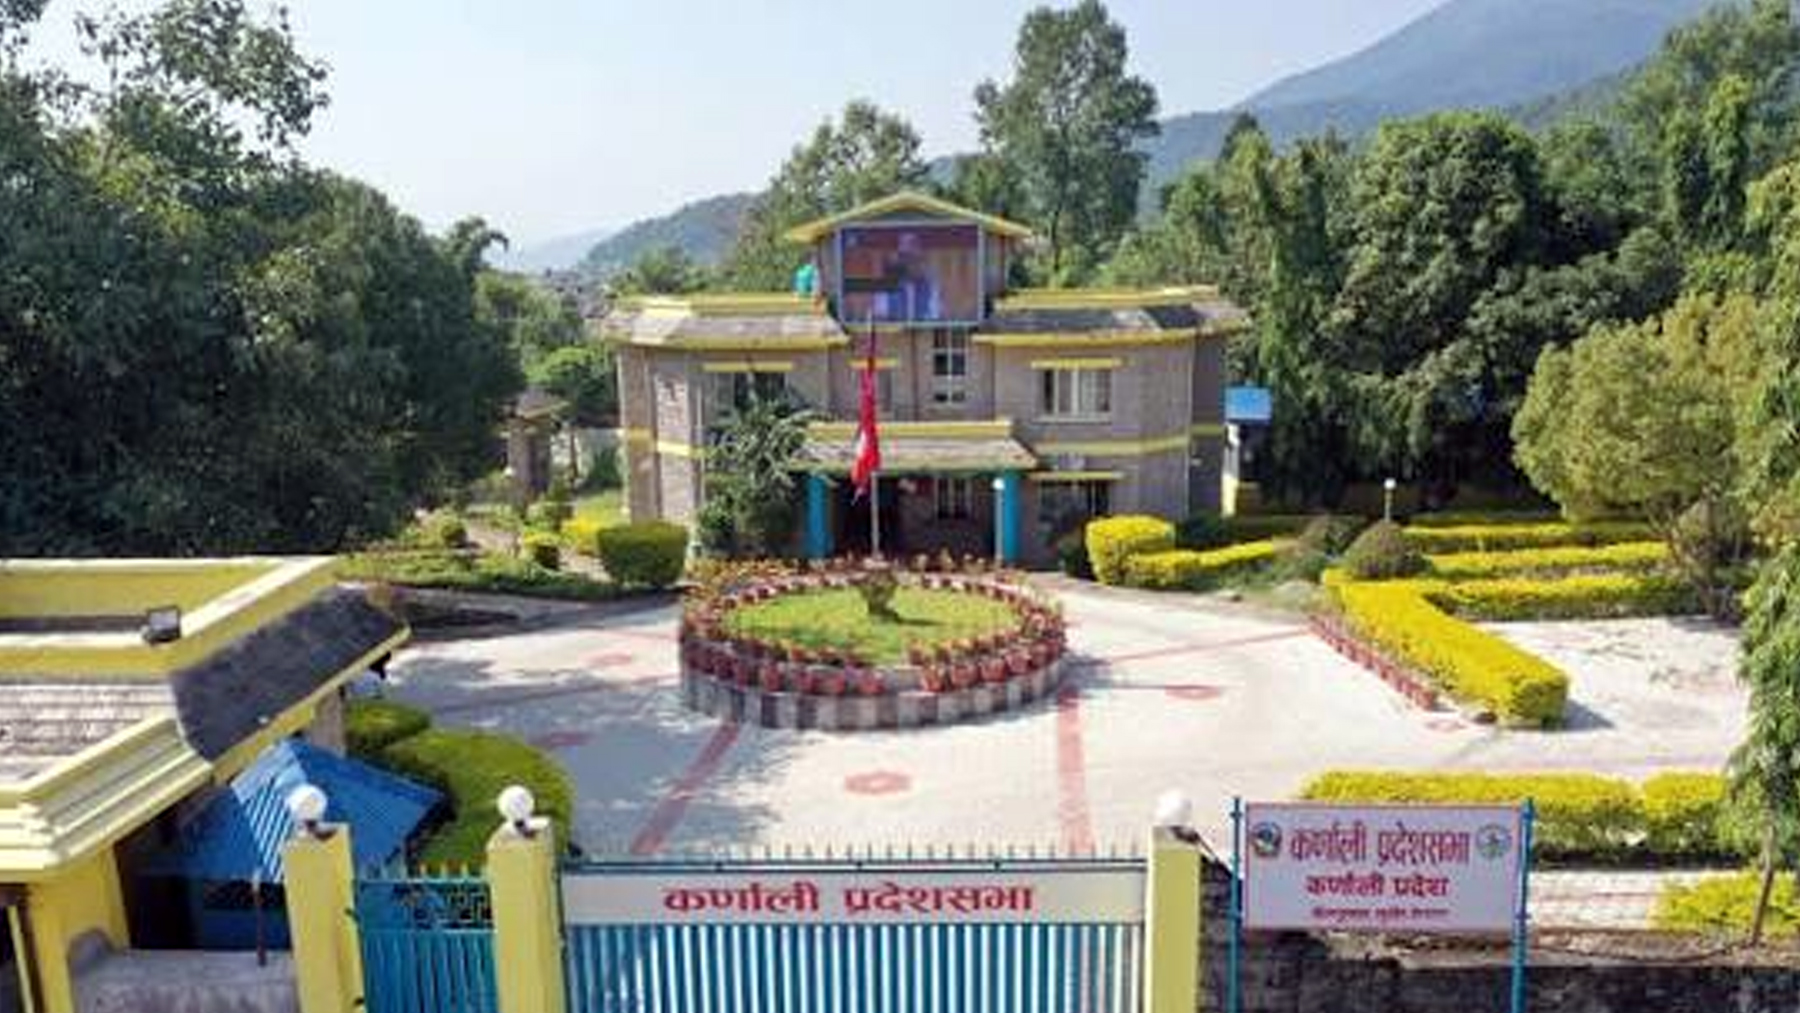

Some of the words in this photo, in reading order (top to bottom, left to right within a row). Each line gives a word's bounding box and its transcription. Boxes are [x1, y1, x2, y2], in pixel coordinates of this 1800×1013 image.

[1290, 821, 1366, 863] कर्णाली
[1378, 821, 1470, 866] प्रदेशसभा
[664, 881, 820, 913] कर्णाली
[844, 882, 1035, 914] प्रदेशसभा
[1306, 873, 1384, 897] कर्णाली
[1394, 874, 1450, 897] प्रदेश
